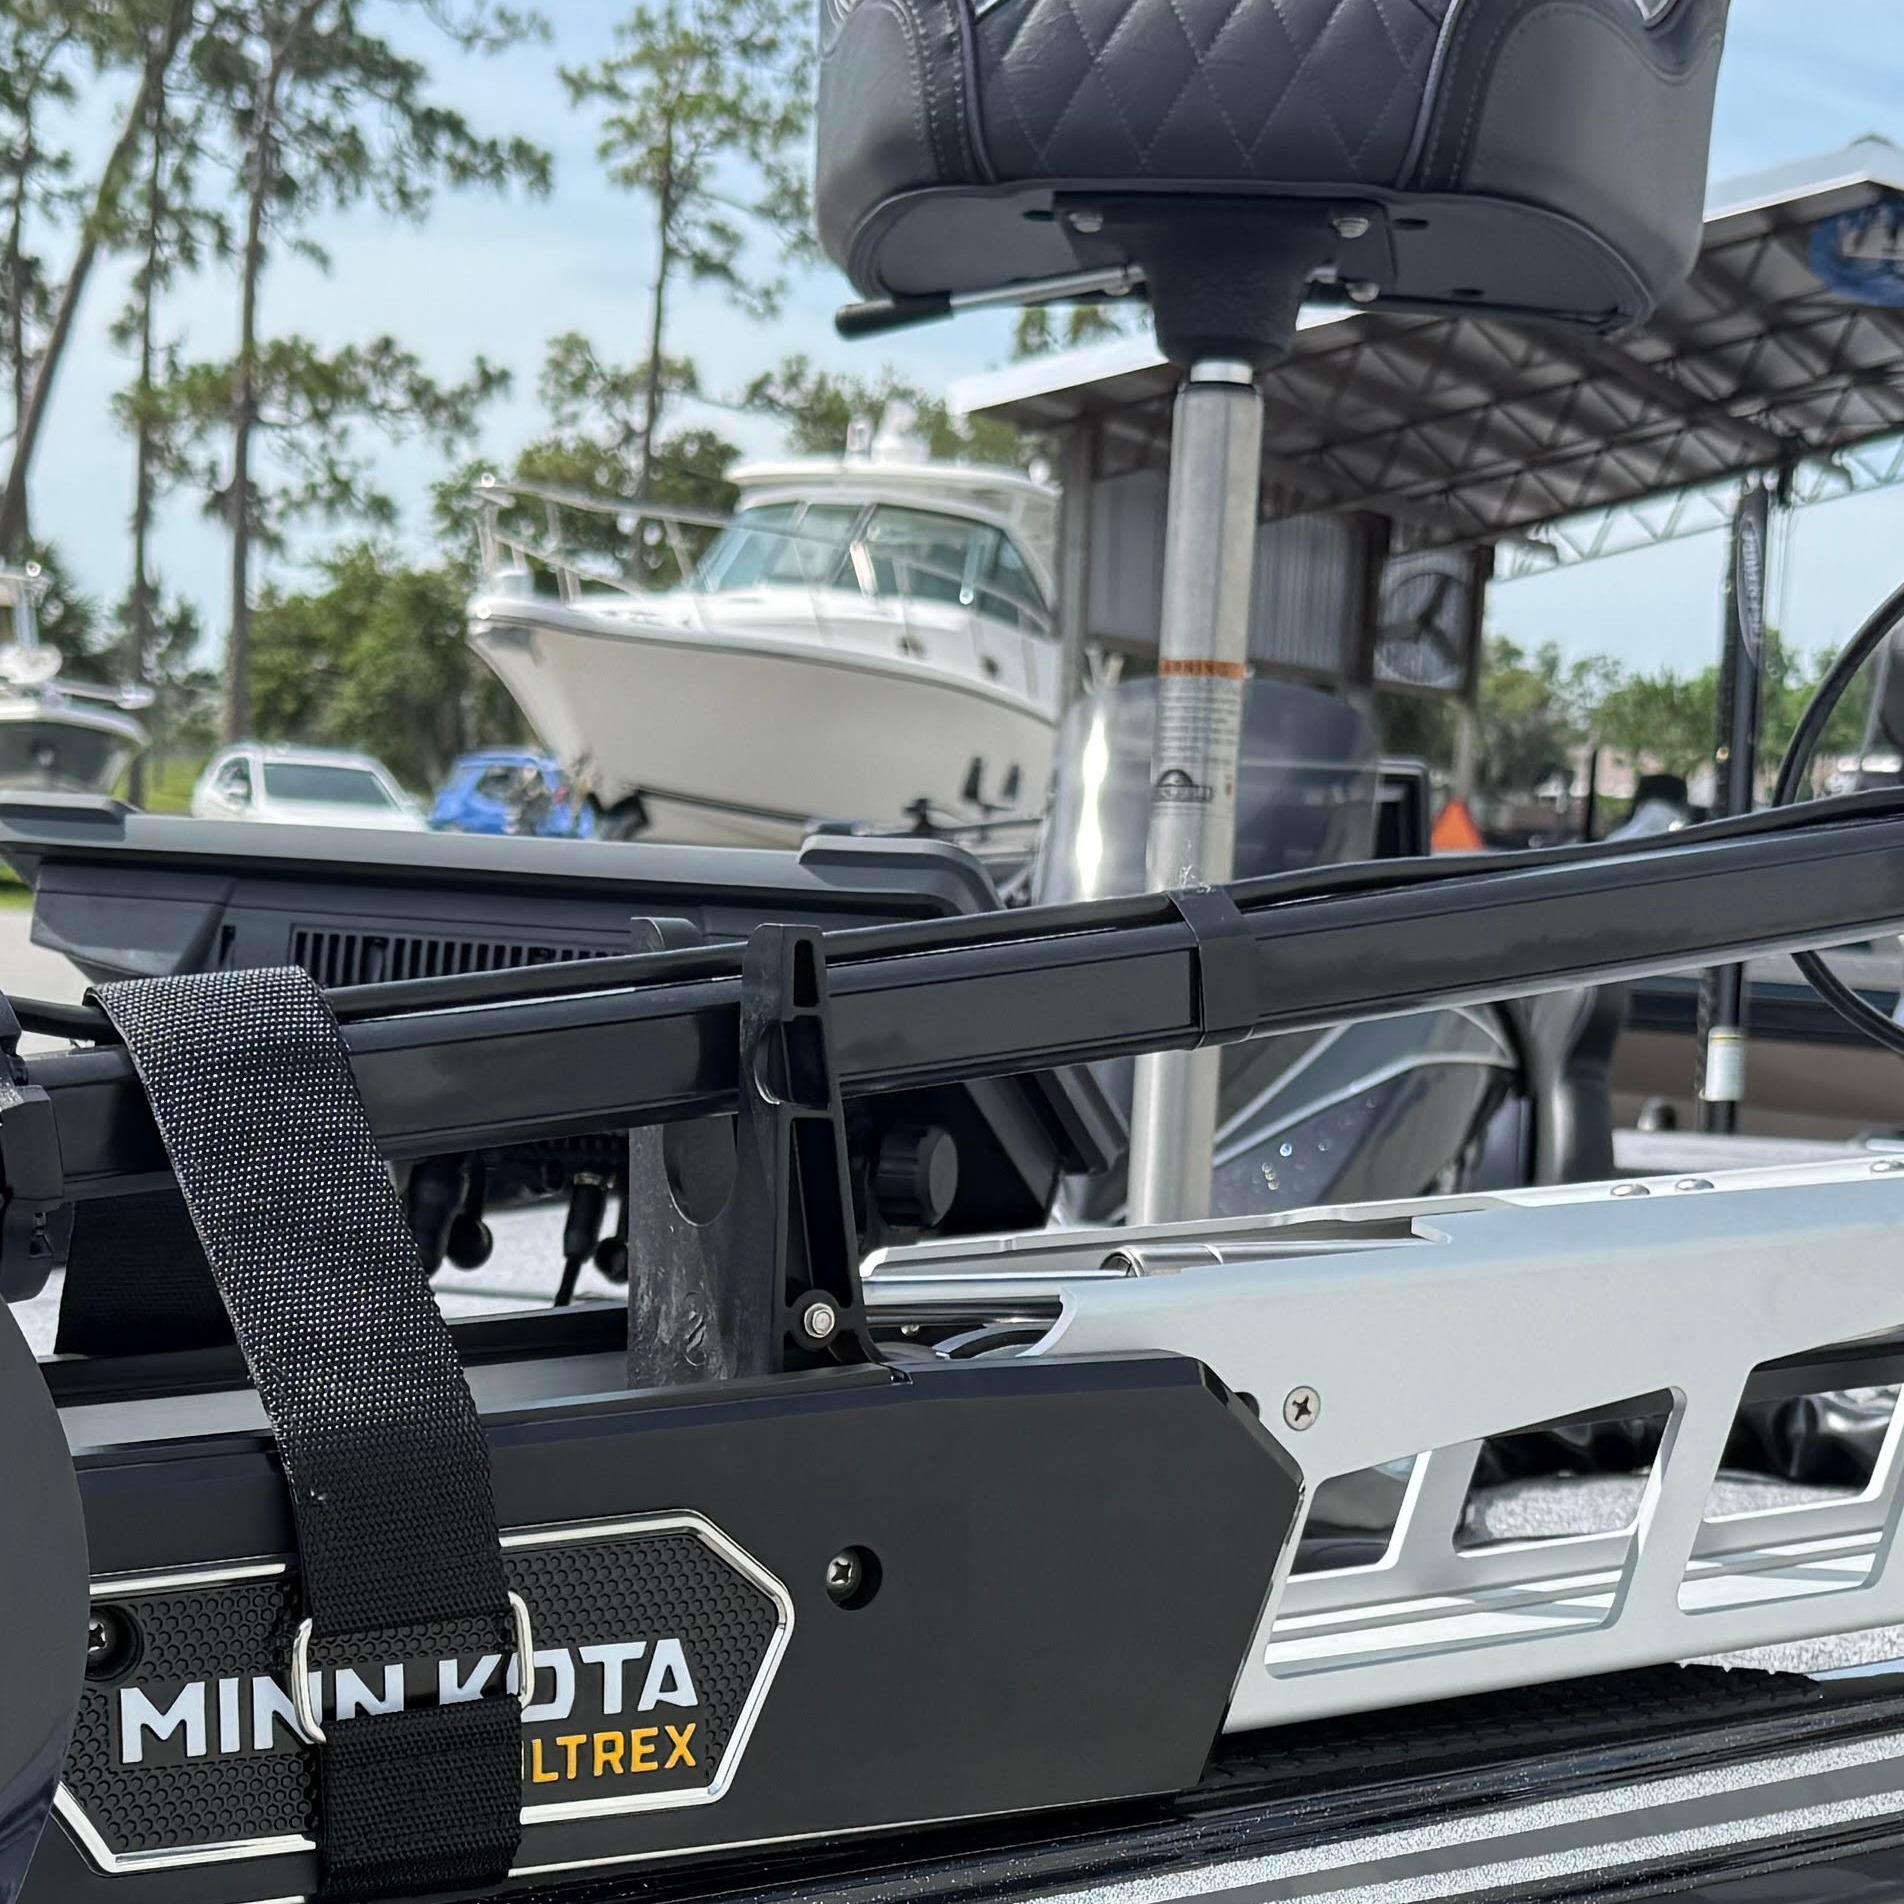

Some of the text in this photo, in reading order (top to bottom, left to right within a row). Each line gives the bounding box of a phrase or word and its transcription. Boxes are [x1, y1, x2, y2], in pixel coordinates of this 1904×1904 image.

[120, 1638, 698, 1764] MINN KOTA
[520, 1722, 697, 1783] LTREX
